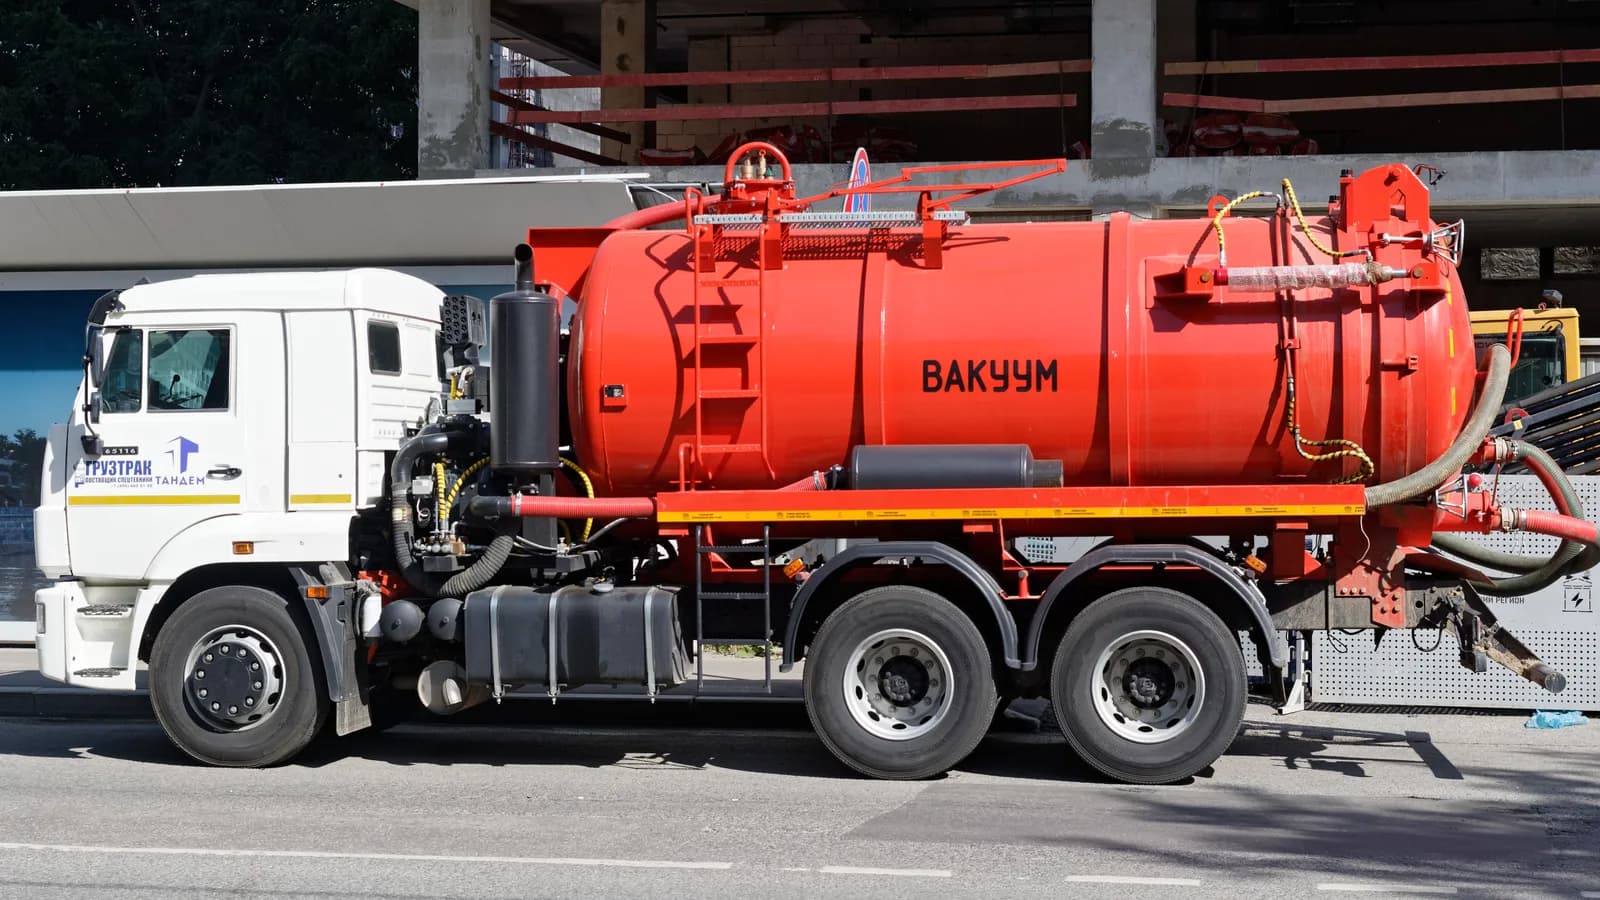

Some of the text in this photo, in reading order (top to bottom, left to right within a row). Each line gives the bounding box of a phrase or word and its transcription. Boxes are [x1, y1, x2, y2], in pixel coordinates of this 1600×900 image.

[922, 359, 1058, 393] ВАКУУМ
[85, 460, 152, 476] ГРУЗТРАК
[155, 476, 205, 486] ТАНДЕМ
